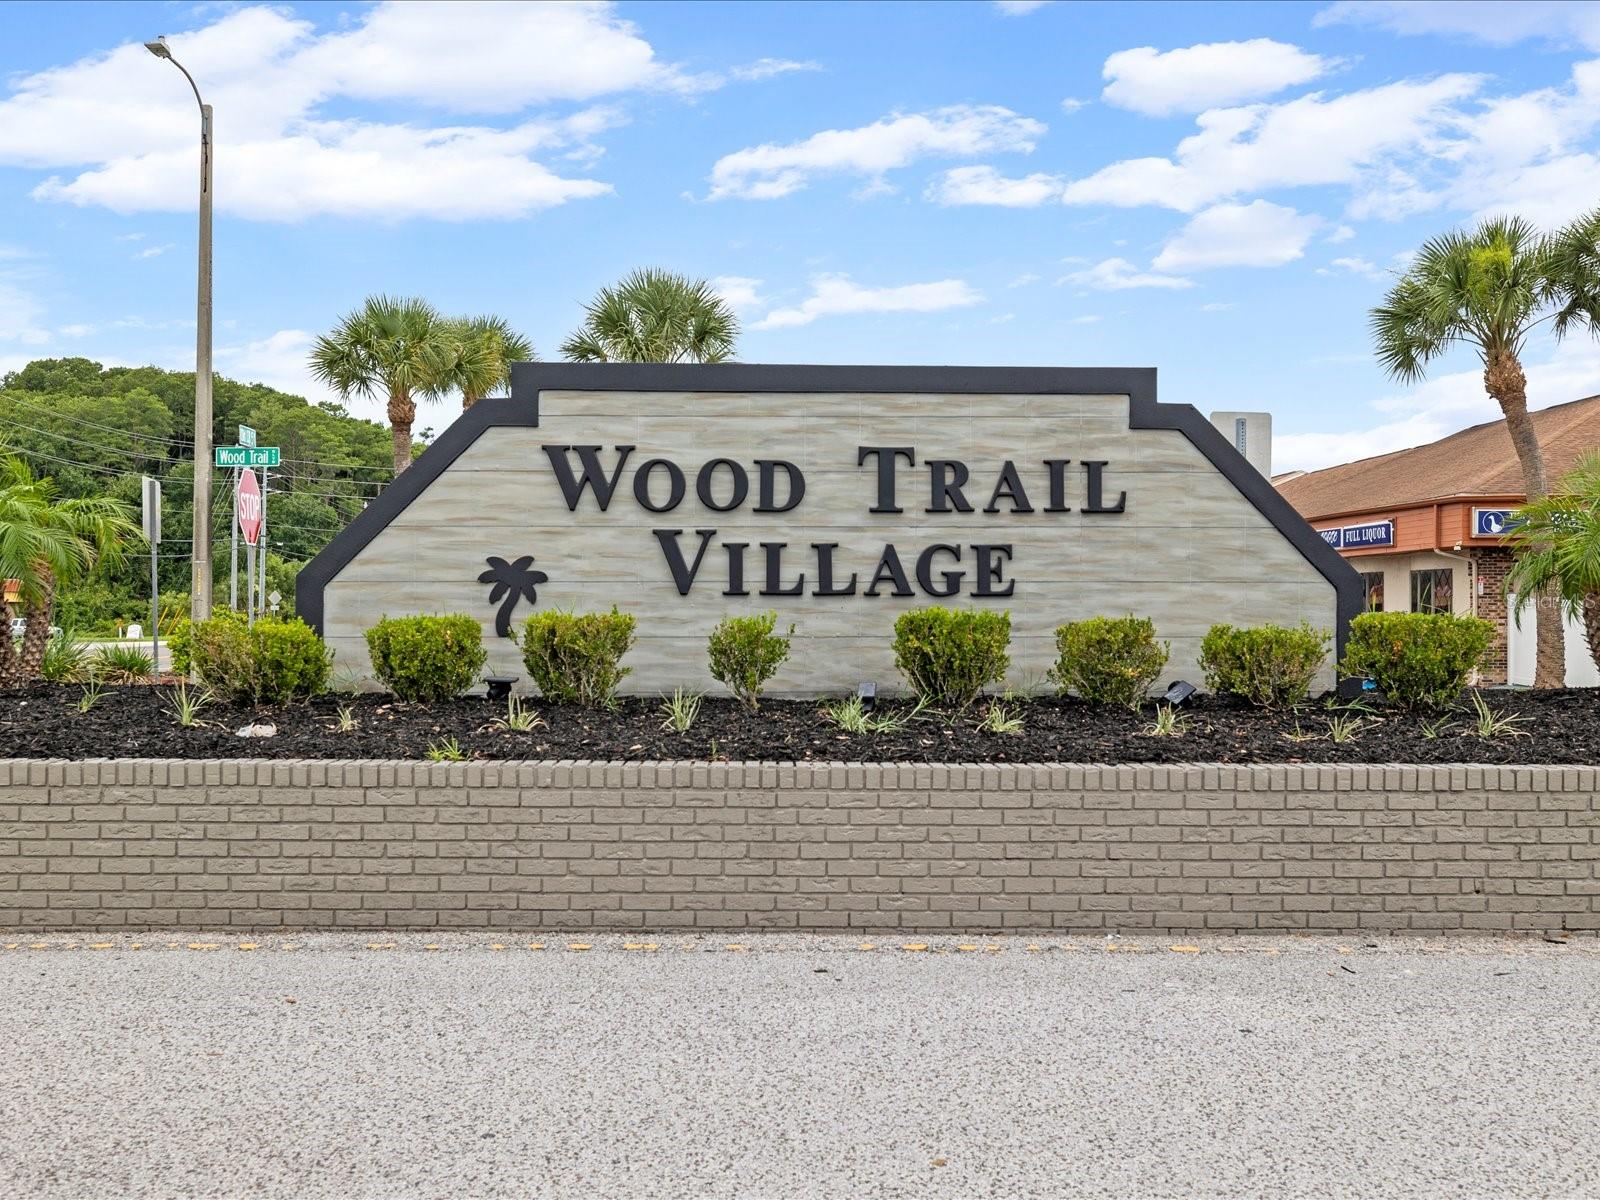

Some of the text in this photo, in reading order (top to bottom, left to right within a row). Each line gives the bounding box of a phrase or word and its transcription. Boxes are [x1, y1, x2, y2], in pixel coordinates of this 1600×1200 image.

[219, 450, 269, 464] Wood Trail
[541, 444, 1127, 514] WOOD TRAIL
[240, 493, 260, 520] STOP
[1345, 529, 1361, 543] FULL
[1362, 526, 1387, 543] LIQUOR
[652, 528, 1016, 598] VILLAGE
